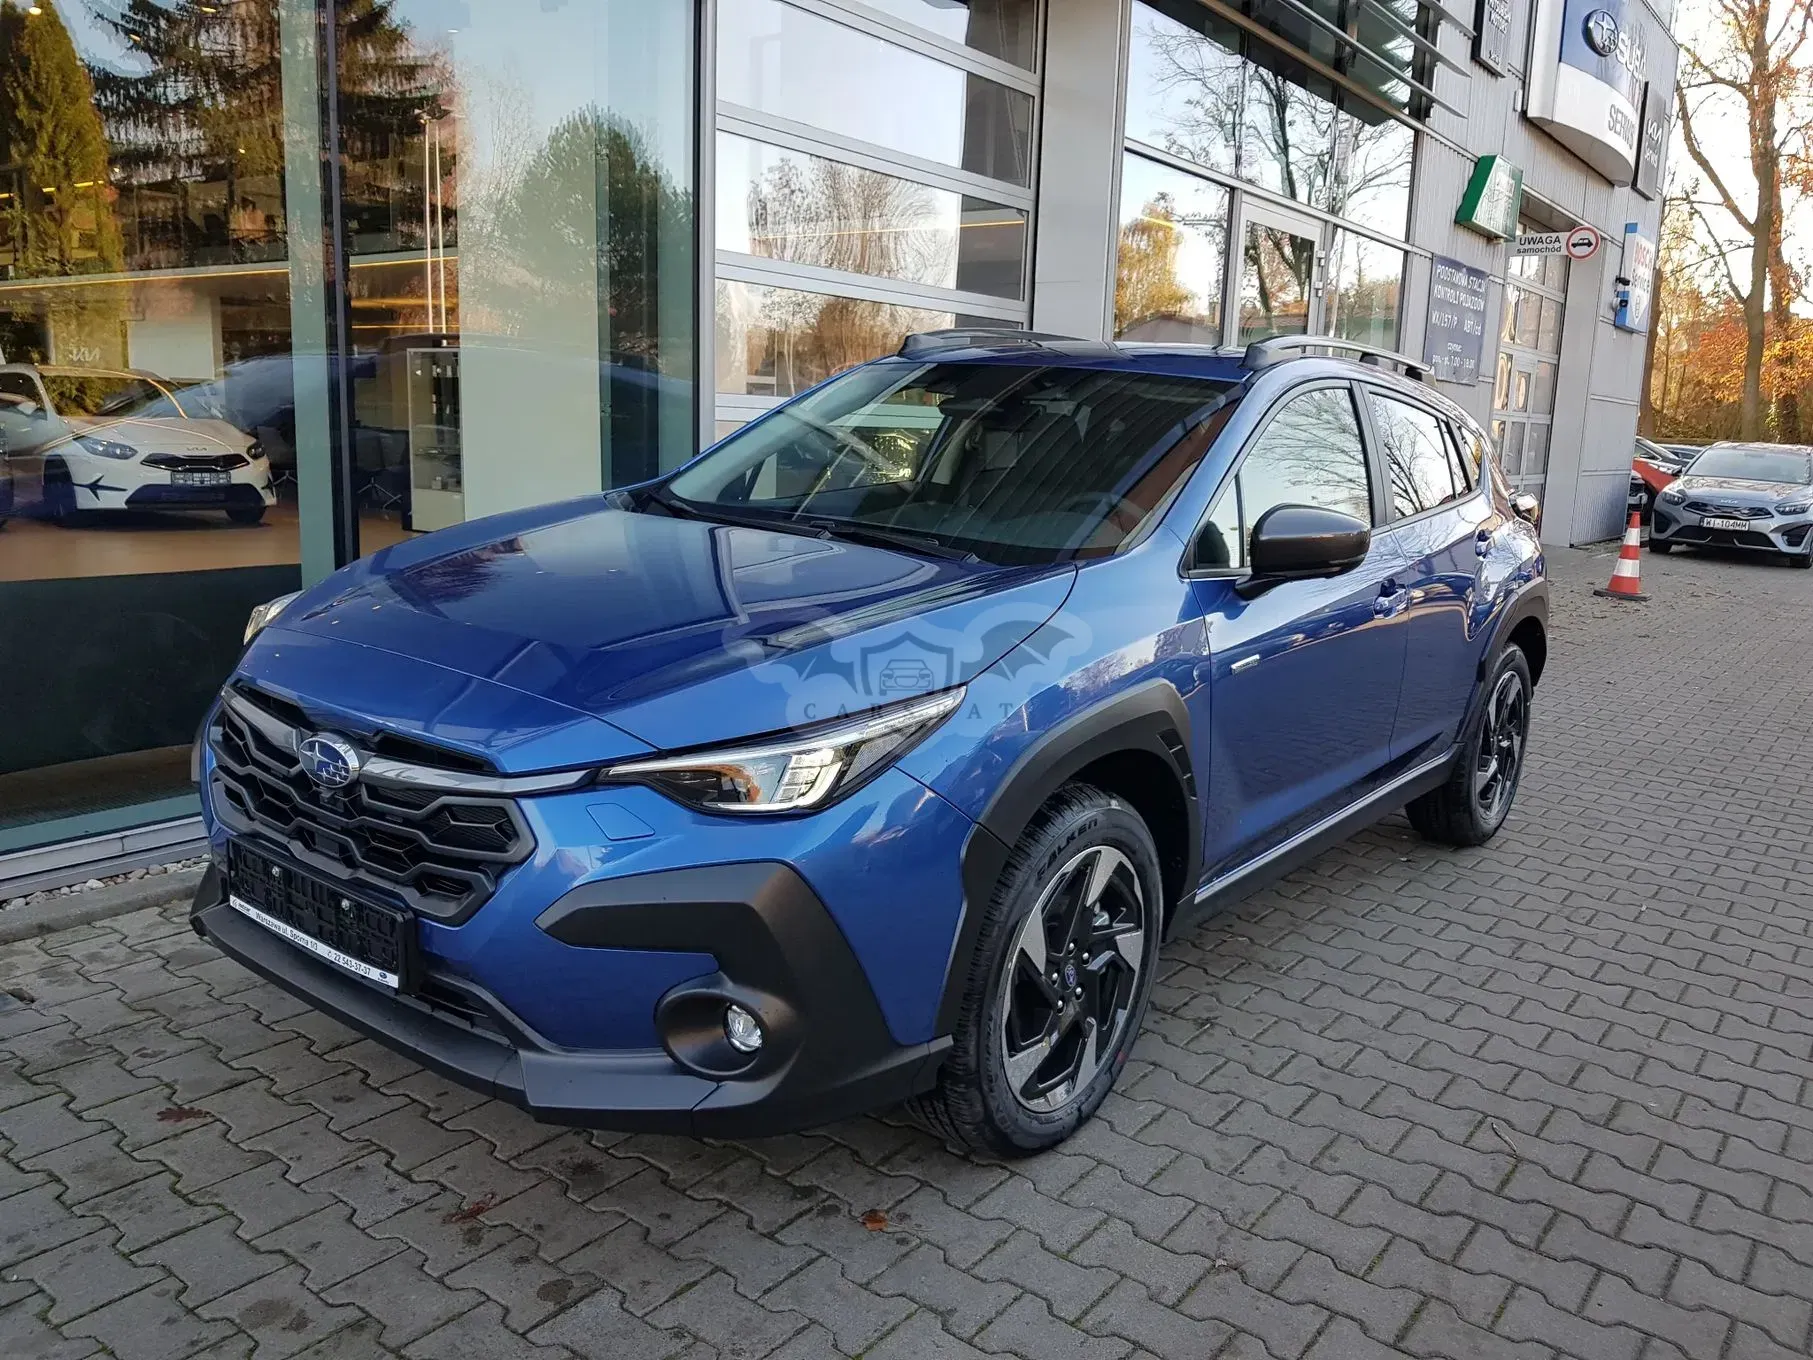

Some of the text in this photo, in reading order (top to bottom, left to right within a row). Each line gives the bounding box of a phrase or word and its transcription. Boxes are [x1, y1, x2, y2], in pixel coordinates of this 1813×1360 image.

[1608, 104, 1635, 150] SERWIS
[1520, 235, 1561, 246] UWAGA
[1516, 245, 1562, 254] samochód
[255, 911, 281, 932] Warszawa
